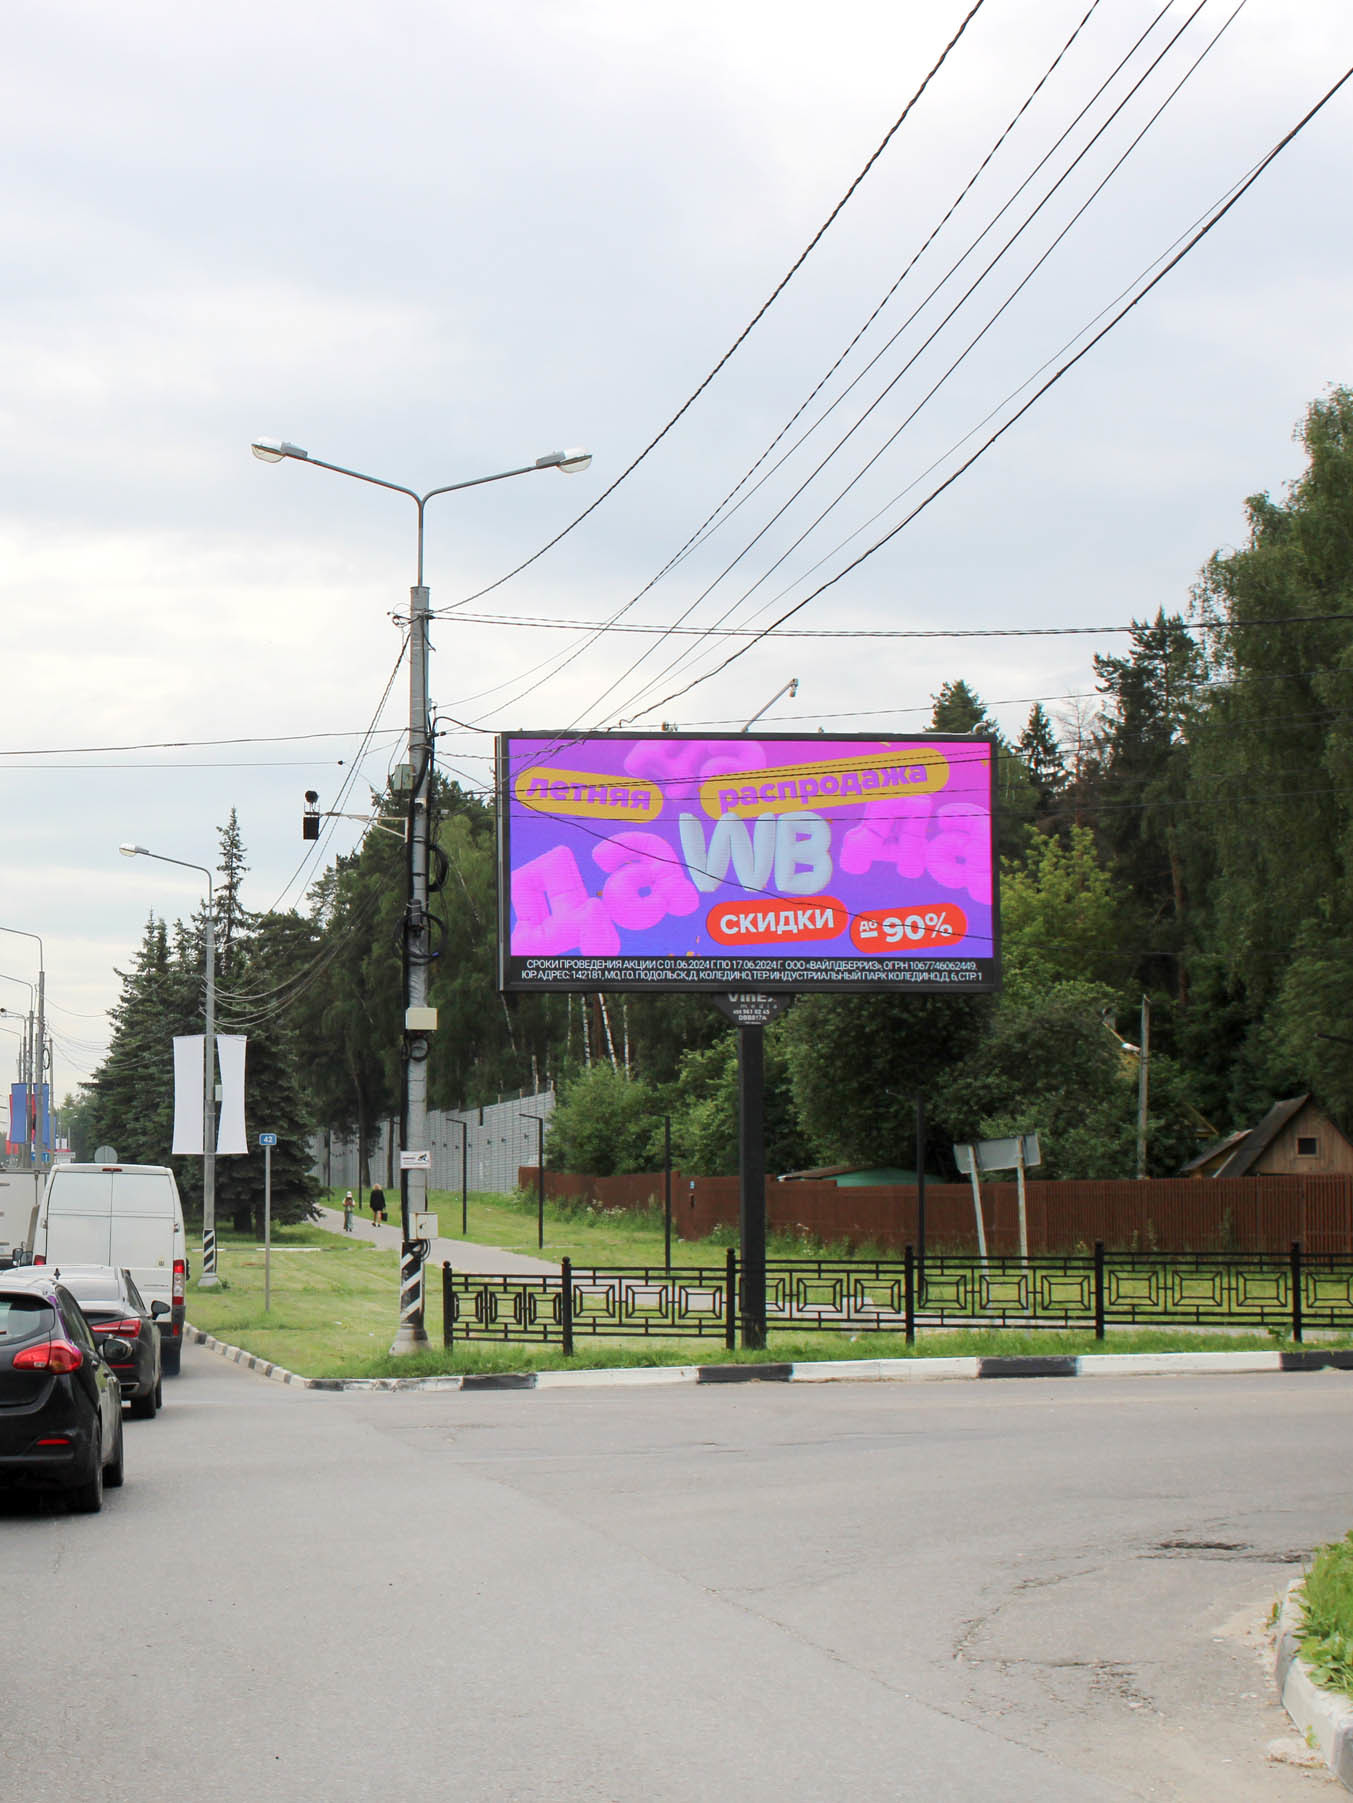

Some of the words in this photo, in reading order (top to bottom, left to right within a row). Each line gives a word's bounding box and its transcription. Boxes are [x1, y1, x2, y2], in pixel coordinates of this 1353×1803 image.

[526, 778, 651, 811] летняя
[718, 764, 928, 814] распродажа
[679, 811, 833, 894] WB
[882, 911, 953, 943] 90%
[521, 970, 537, 980] ЮР.
[571, 970, 604, 981] 142181,
[770, 969, 861, 982] ИНДУСТРИАЛЬНЫЙ
[862, 971, 888, 981] ПАРК
[526, 959, 559, 969] СРОКИ
[559, 959, 622, 971] ПРОВЕДЕНИЯ
[623, 959, 656, 971] АКЦИИ
[656, 959, 665, 969] С
[664, 959, 710, 970] 01.06.2024
[716, 959, 731, 970] ПО
[732, 959, 777, 970] 17.06.2024
[785, 960, 805, 970] ООО
[883, 960, 909, 970] ОГРН
